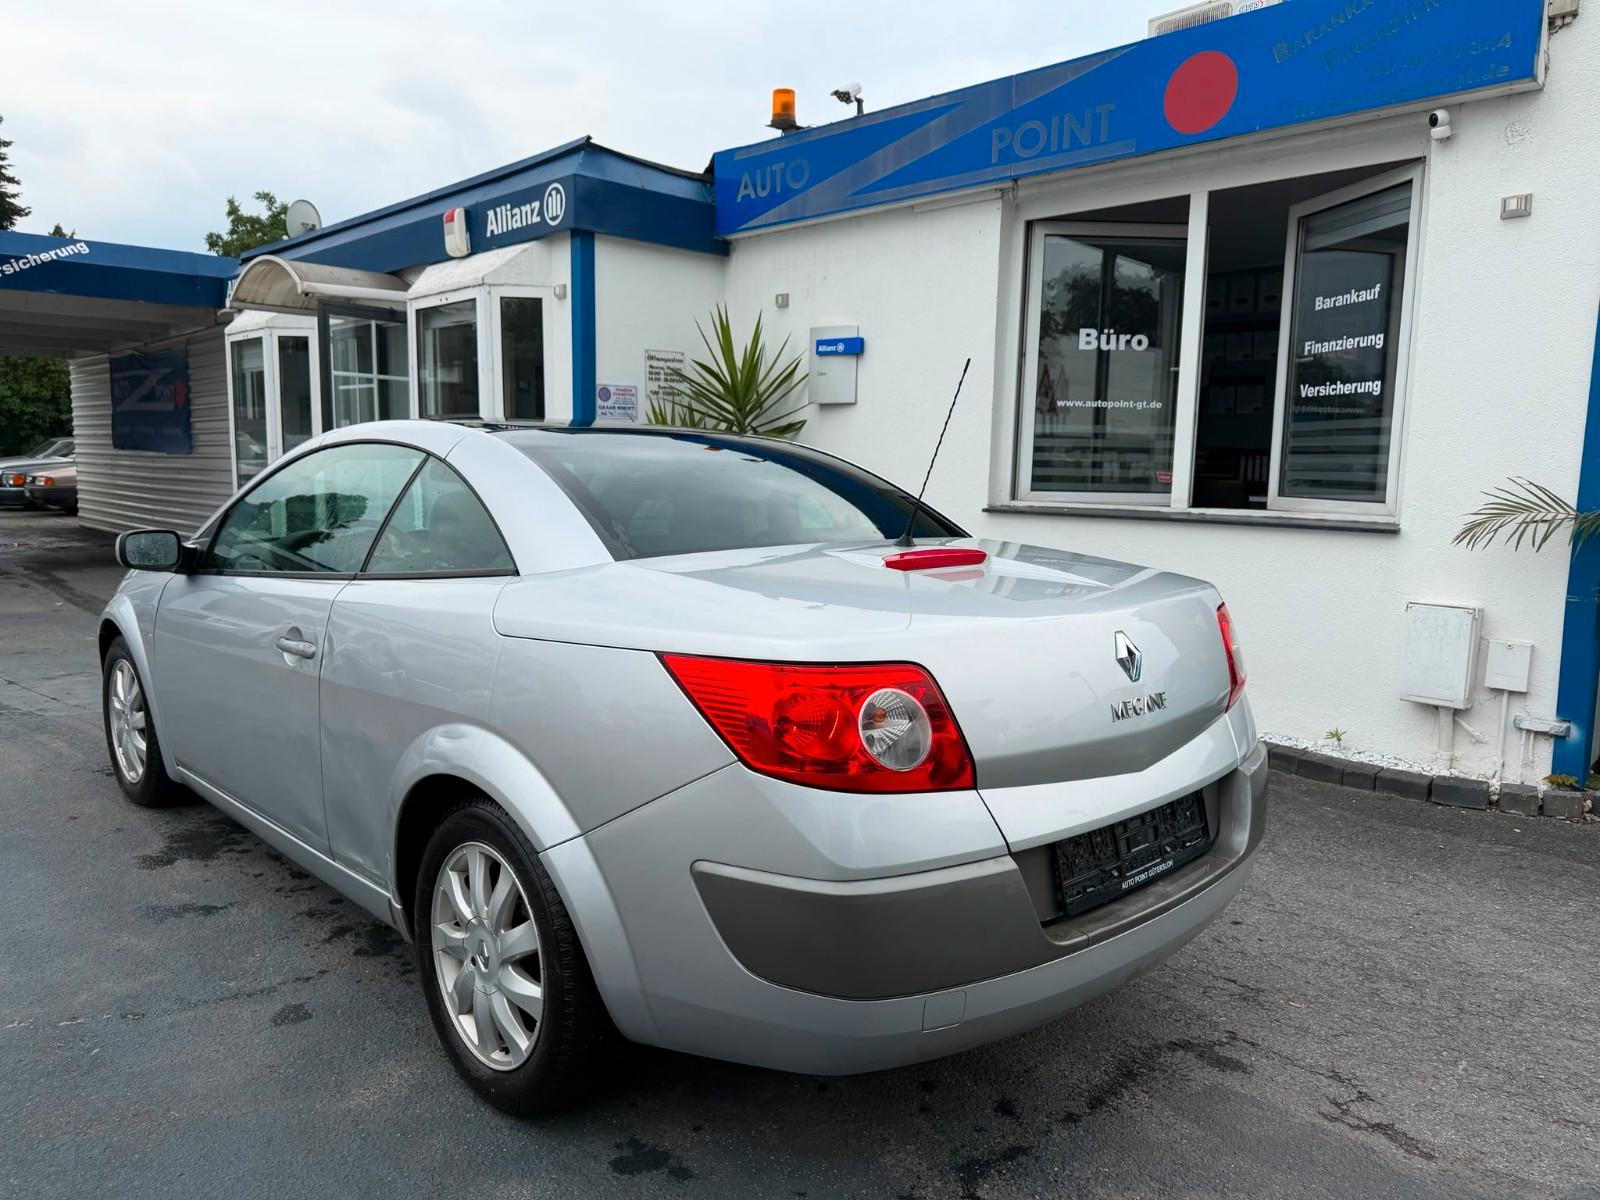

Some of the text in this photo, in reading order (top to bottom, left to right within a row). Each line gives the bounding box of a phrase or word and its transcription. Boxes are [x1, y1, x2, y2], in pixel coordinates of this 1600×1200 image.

[990, 103, 1118, 164] POINT
[736, 158, 811, 202] AUTO
[486, 200, 541, 238] Allianz
[1314, 283, 1381, 311] Barankauf
[818, 343, 837, 352] Allianz
[1078, 327, 1150, 351] Büro
[1304, 333, 1385, 355] Finanzierung
[1300, 380, 1382, 398] Versicherung
[1056, 398, 1163, 410] www.autopoint-gt.de
[1121, 877, 1135, 890] AUTO
[1134, 871, 1149, 884] POINT
